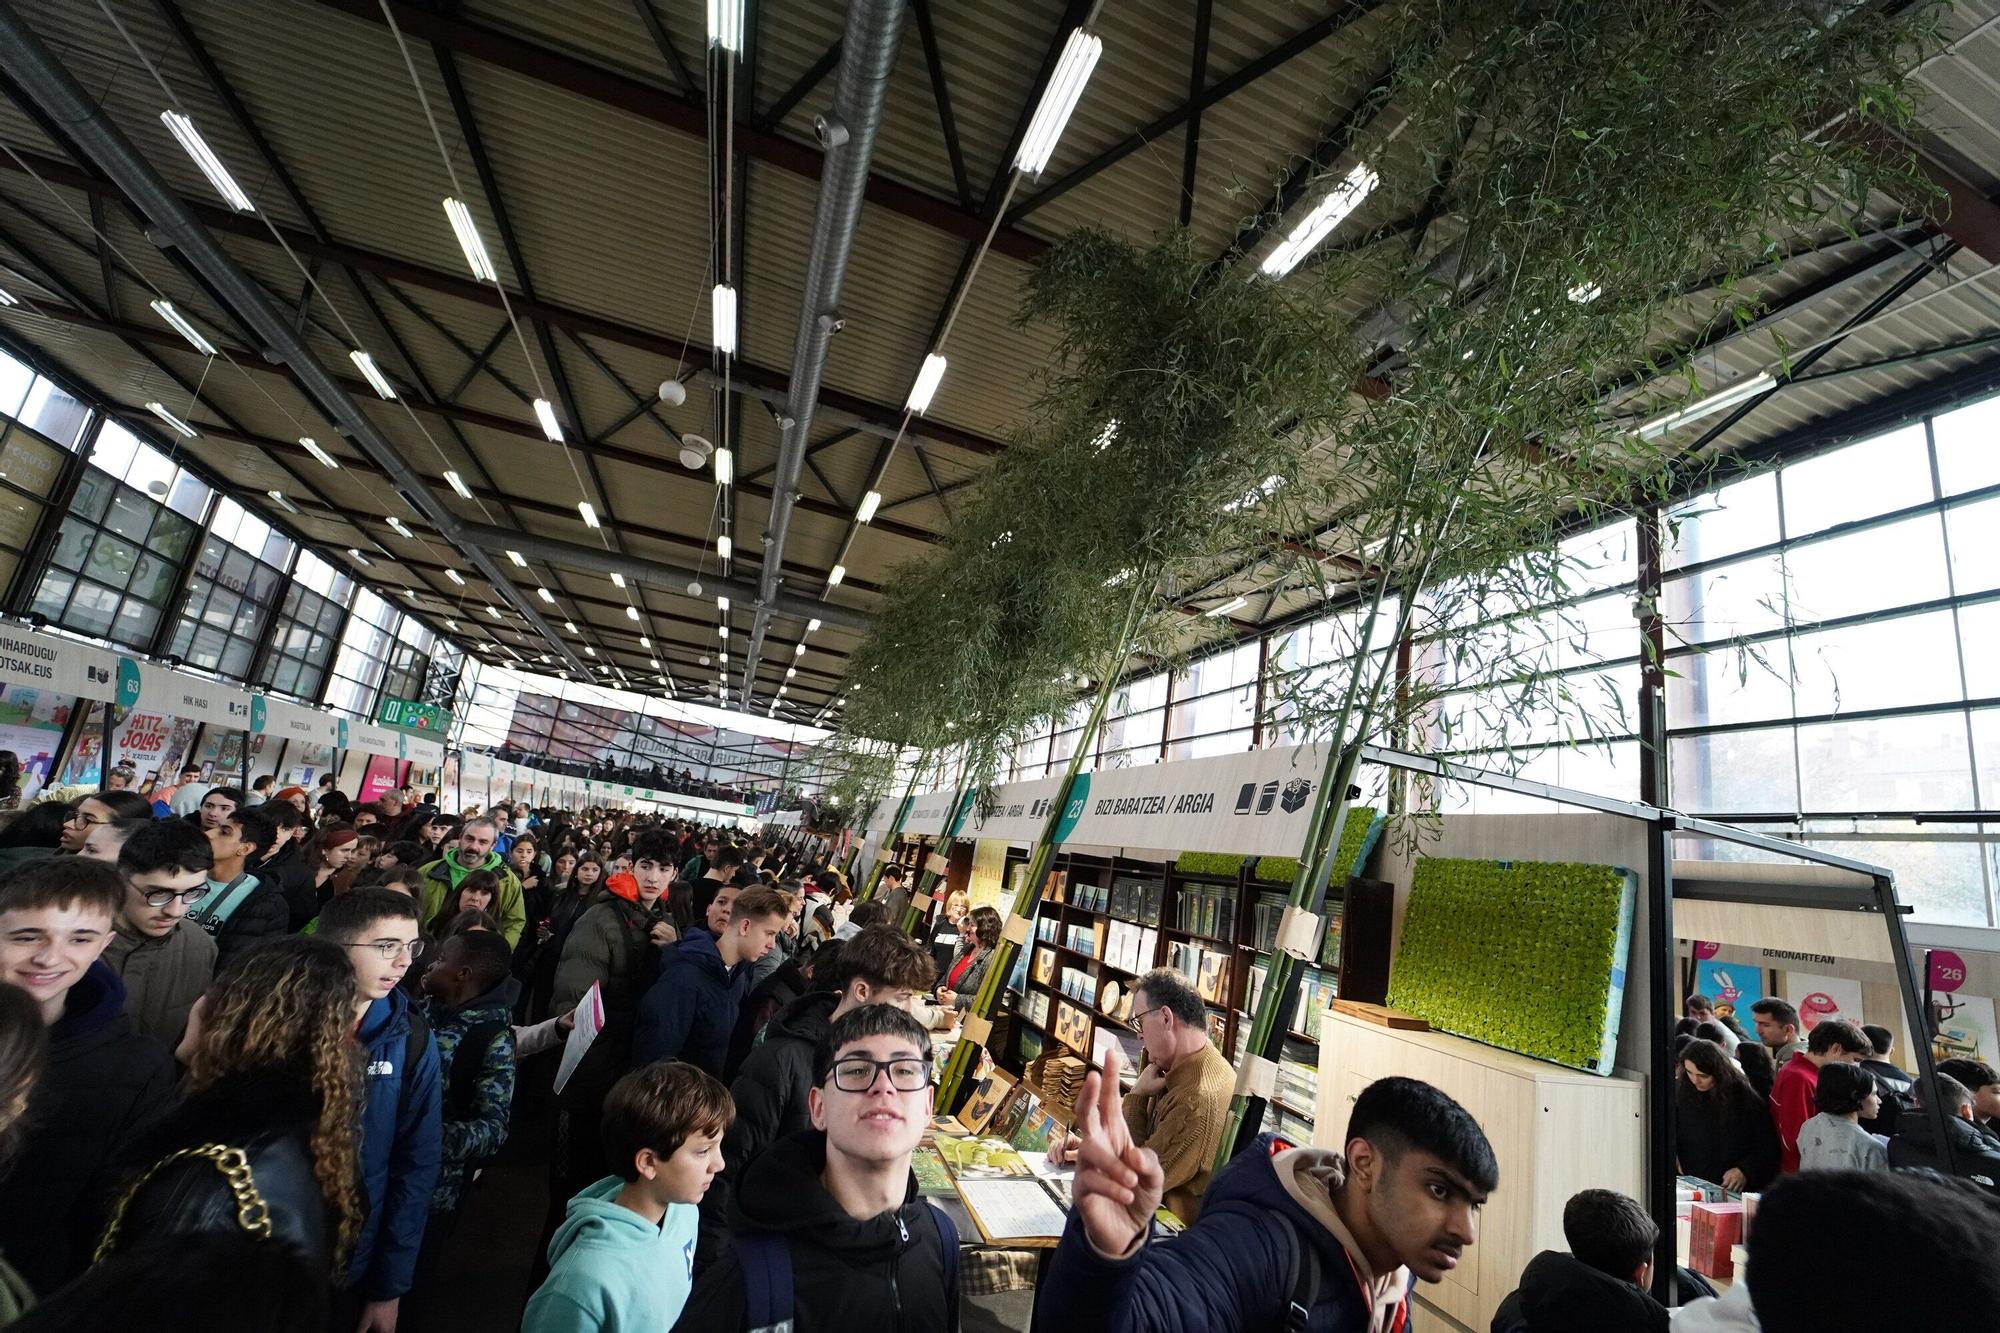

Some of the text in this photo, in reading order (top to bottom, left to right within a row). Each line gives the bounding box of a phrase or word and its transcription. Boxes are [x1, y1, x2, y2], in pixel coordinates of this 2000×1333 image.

[127, 680, 139, 693] 63
[183, 695, 208, 709] HIK HASI
[385, 701, 401, 722] 01
[131, 714, 162, 732] HITZ
[120, 730, 165, 752] JOLAS
[1067, 799, 1083, 818] 23
[1095, 799, 1114, 815] BIZI
[1113, 796, 1165, 815] BARATZEA
[1174, 793, 1215, 814] ARGIA
[1762, 948, 1835, 965] DENONARTEAN
[1942, 967, 1962, 981] 26
